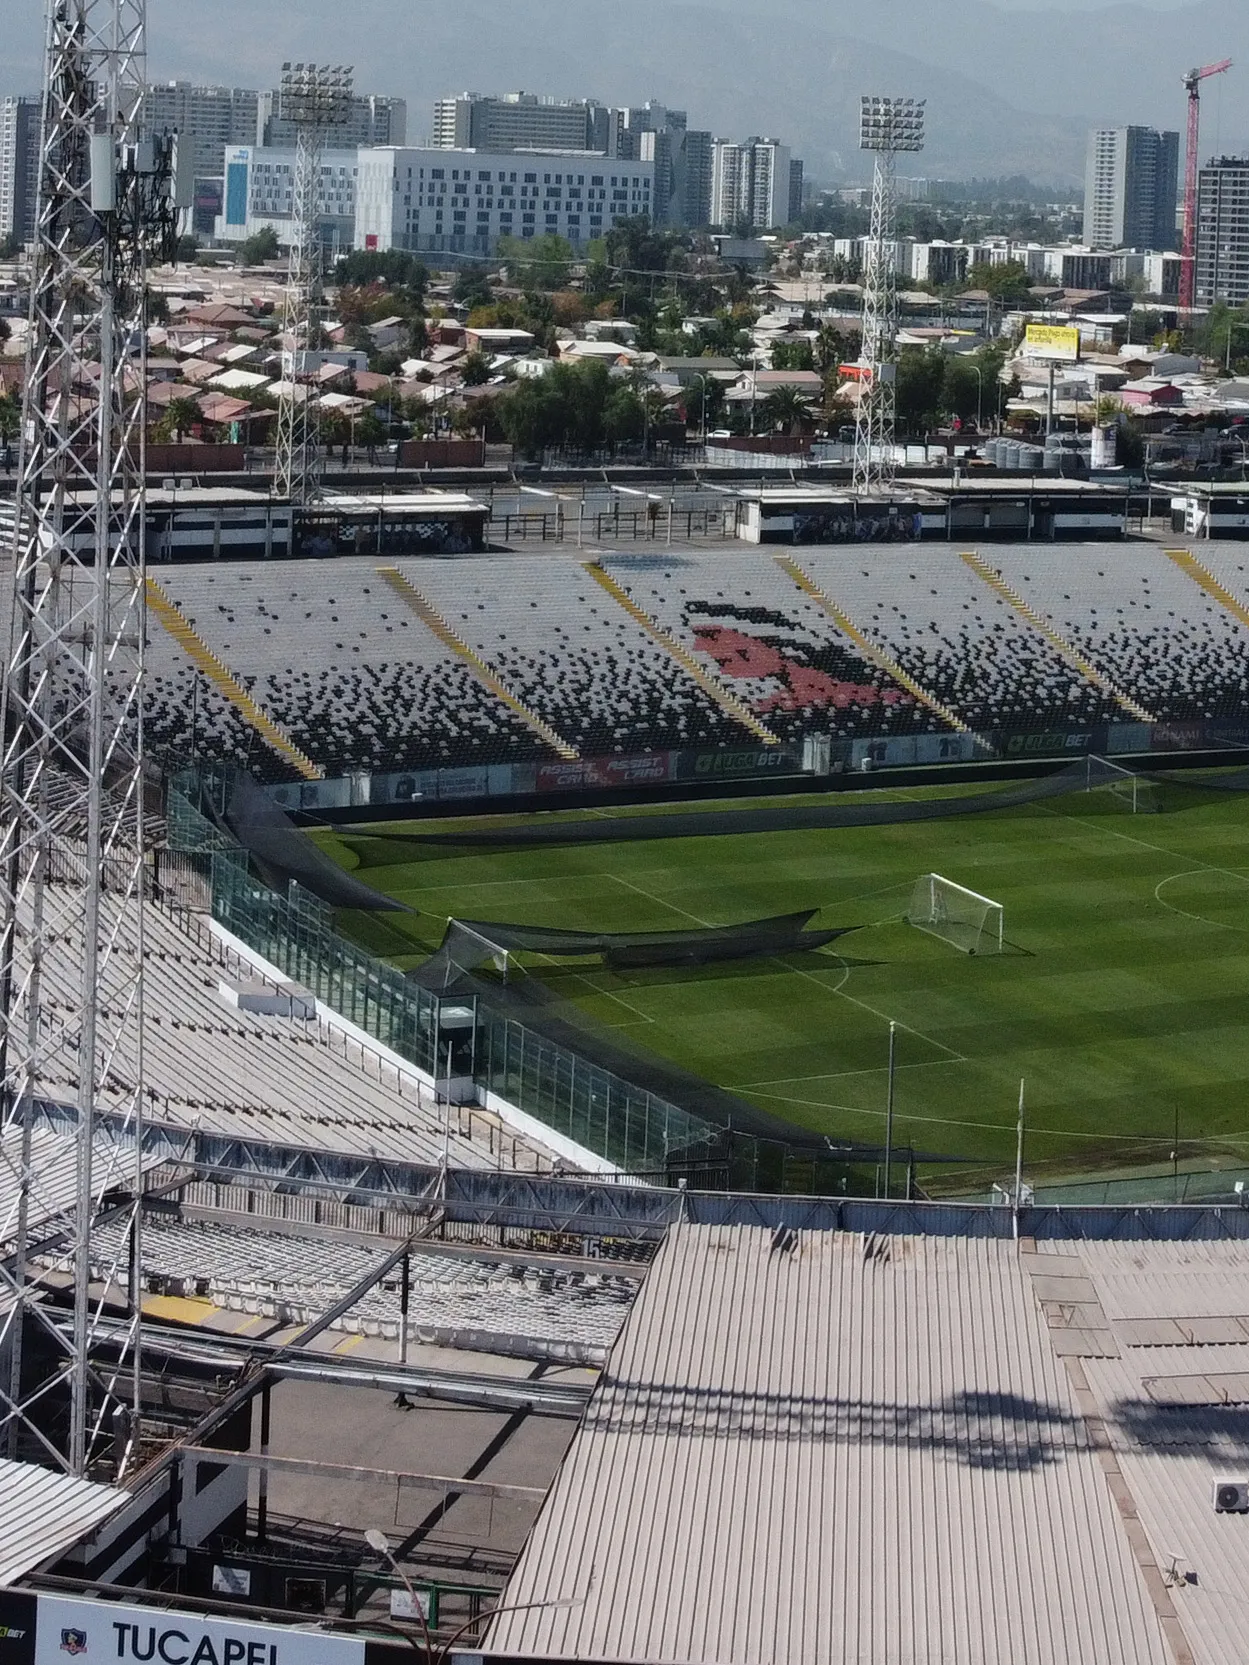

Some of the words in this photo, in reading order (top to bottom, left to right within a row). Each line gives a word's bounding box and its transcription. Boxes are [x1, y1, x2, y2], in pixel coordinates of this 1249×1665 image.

[540, 762, 597, 776] ASSIST
[607, 757, 663, 771] ASSIST
[624, 767, 665, 781] CARD
[581, 1239, 600, 1259] 15
